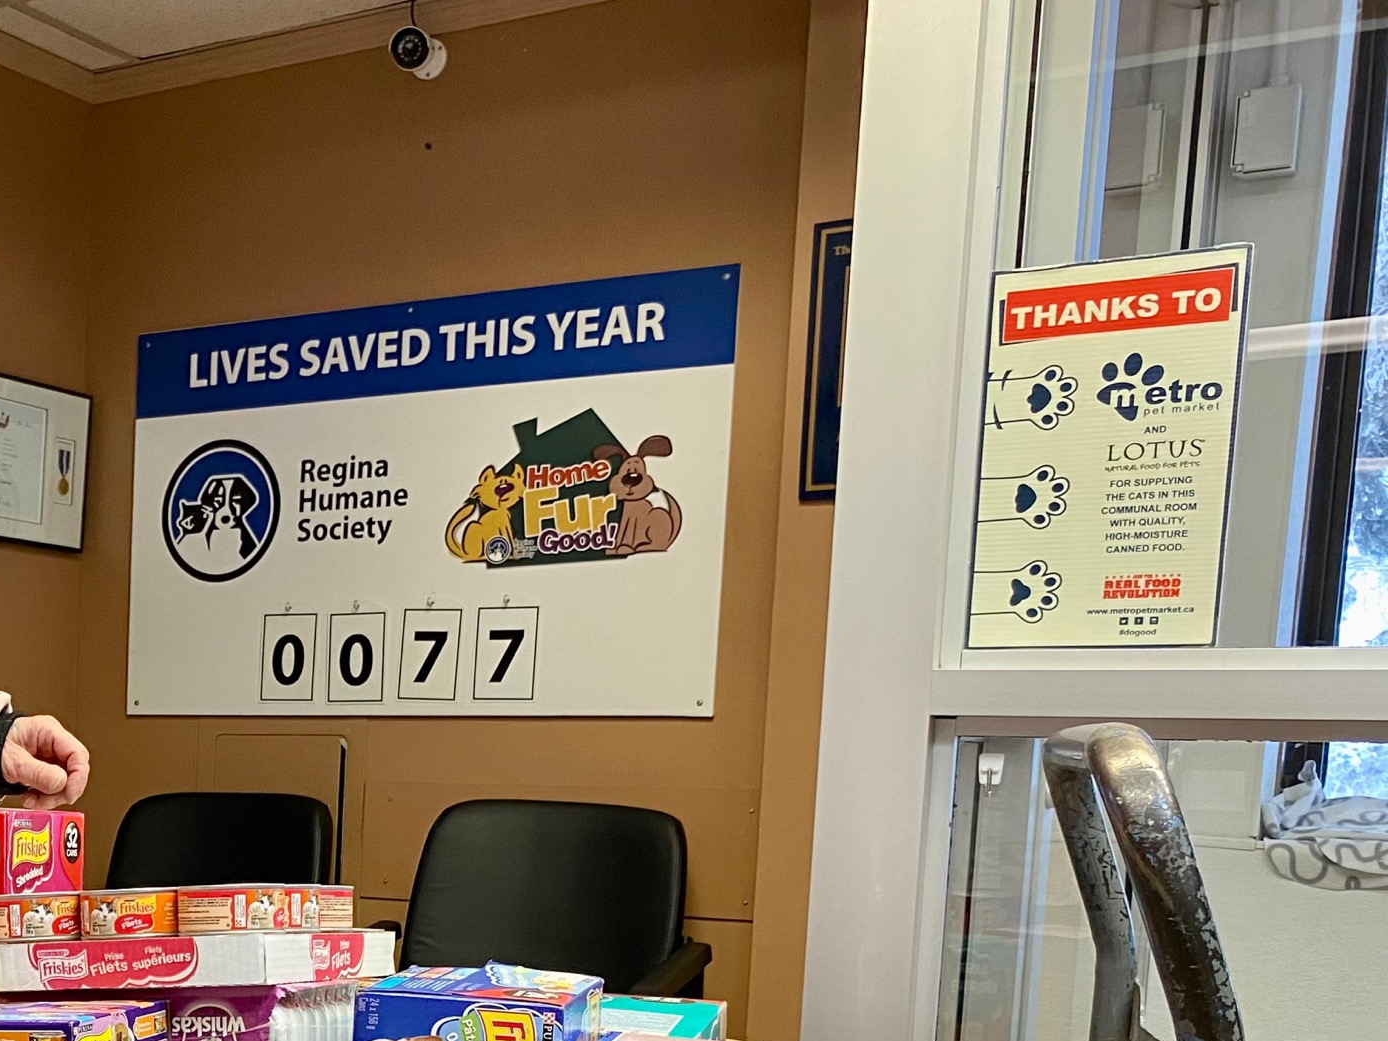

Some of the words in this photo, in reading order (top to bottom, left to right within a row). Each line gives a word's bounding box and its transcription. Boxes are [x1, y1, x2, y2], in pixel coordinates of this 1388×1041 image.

[1010, 294, 1160, 329] THANKS
[1172, 288, 1221, 314] TO
[188, 343, 289, 388] LIVES
[299, 329, 430, 377] SAVED
[440, 316, 535, 362] THIS
[548, 303, 666, 351] YEAR
[1144, 407, 1164, 417] pet
[1172, 403, 1220, 413] market
[1144, 426, 1166, 434] AND
[1106, 439, 1203, 461] LOTUS
[300, 456, 389, 486] Regina
[527, 459, 610, 489] Home
[1134, 476, 1193, 486] SUPPLYING
[298, 486, 408, 513] Humane
[1106, 493, 1125, 501] THE
[1172, 490, 1195, 498] THIS
[523, 489, 616, 538] Fur
[1101, 505, 1162, 514] COMMUNAL
[1165, 503, 1197, 511] ROOM
[1139, 517, 1185, 526] QUALITY,
[297, 517, 392, 545] Society
[539, 523, 618, 553] Good!
[1105, 530, 1188, 540] HIGH-MOISTURE
[1106, 545, 1149, 553] CANNED
[1152, 543, 1185, 552] FOOD.
[1105, 580, 1140, 589] REAL
[1145, 578, 1181, 588] FOOD
[1103, 589, 1180, 599] REVOLUTION
[1087, 607, 1194, 615] www.metropetmarket.ca
[16, 866, 43, 888] Shredded
[42, 961, 84, 977] Friskies
[90, 961, 128, 976] Filets
[171, 1015, 245, 1037] whiskas
